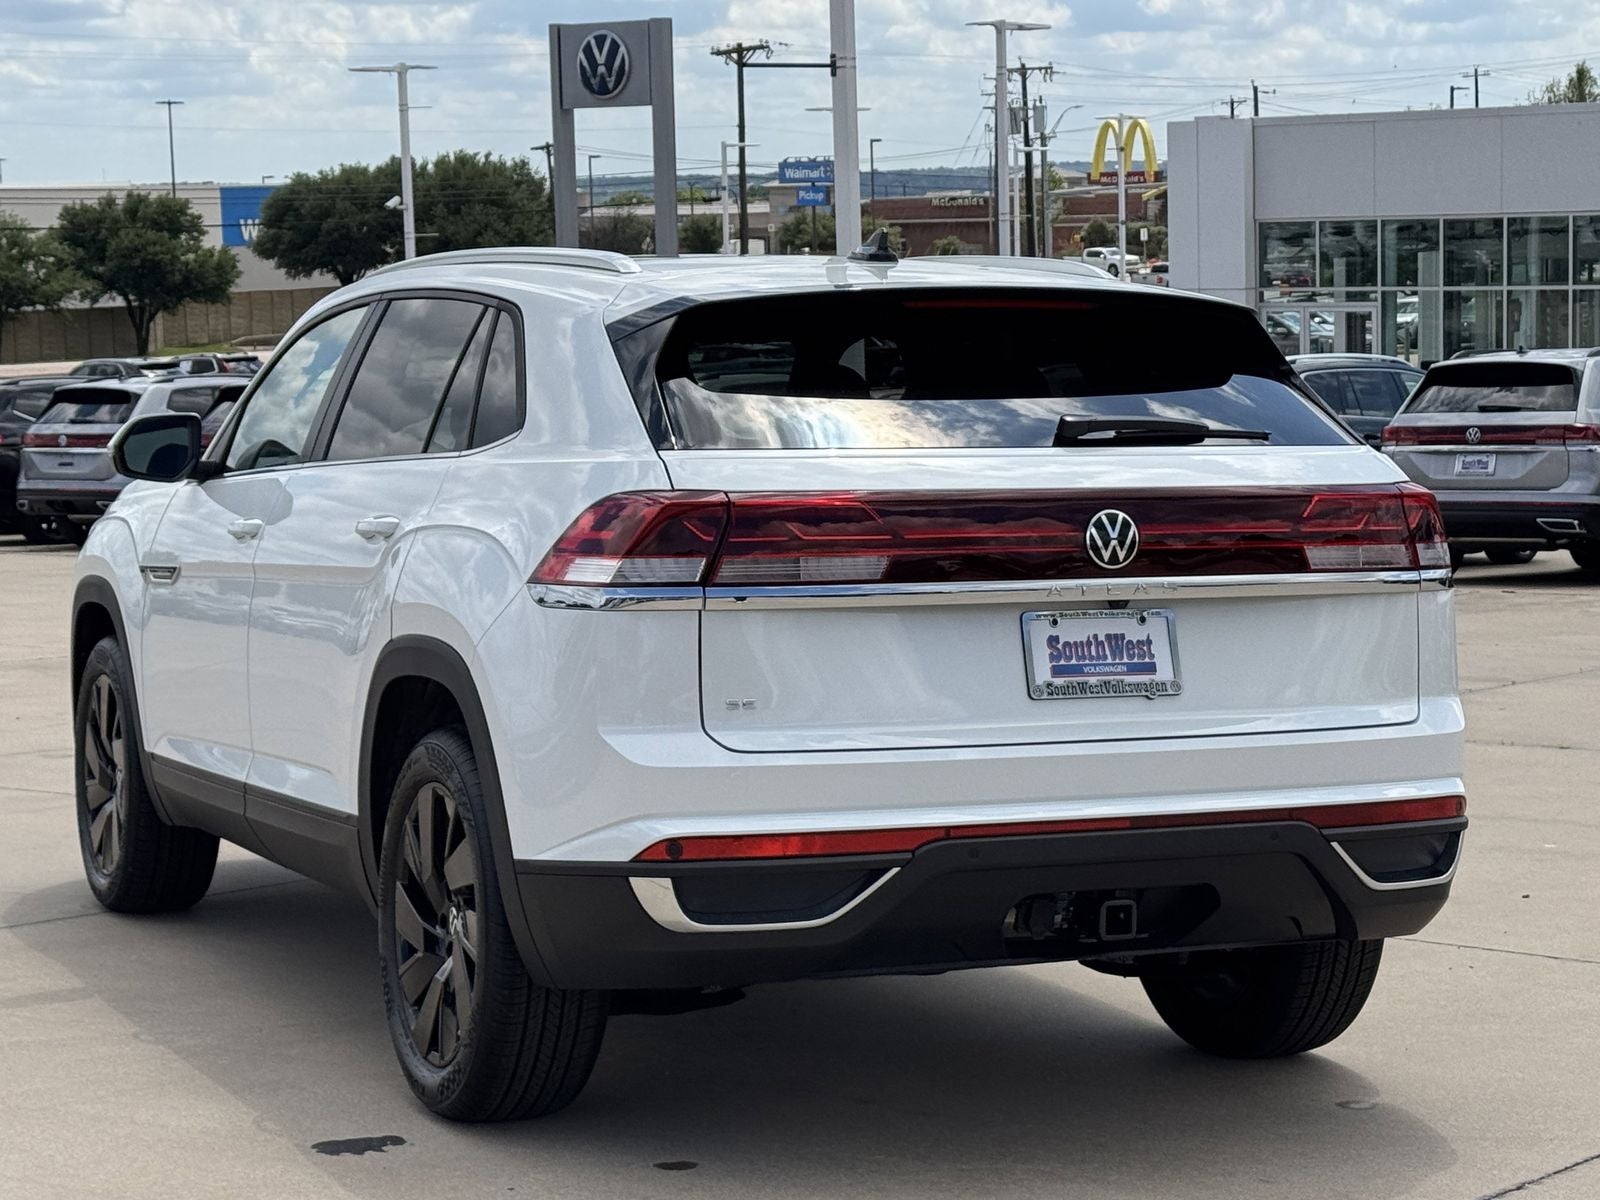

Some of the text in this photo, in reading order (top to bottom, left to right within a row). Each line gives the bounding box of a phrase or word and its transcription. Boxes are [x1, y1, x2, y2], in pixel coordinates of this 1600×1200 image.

[784, 166, 825, 179] Walmart
[798, 189, 825, 202] Pickup
[931, 196, 985, 207] McDonald's
[1046, 581, 1178, 598] ATLAS
[1083, 664, 1127, 674] VOLKSWAGEN
[1046, 679, 1169, 698] SouthWestVolkswagen
